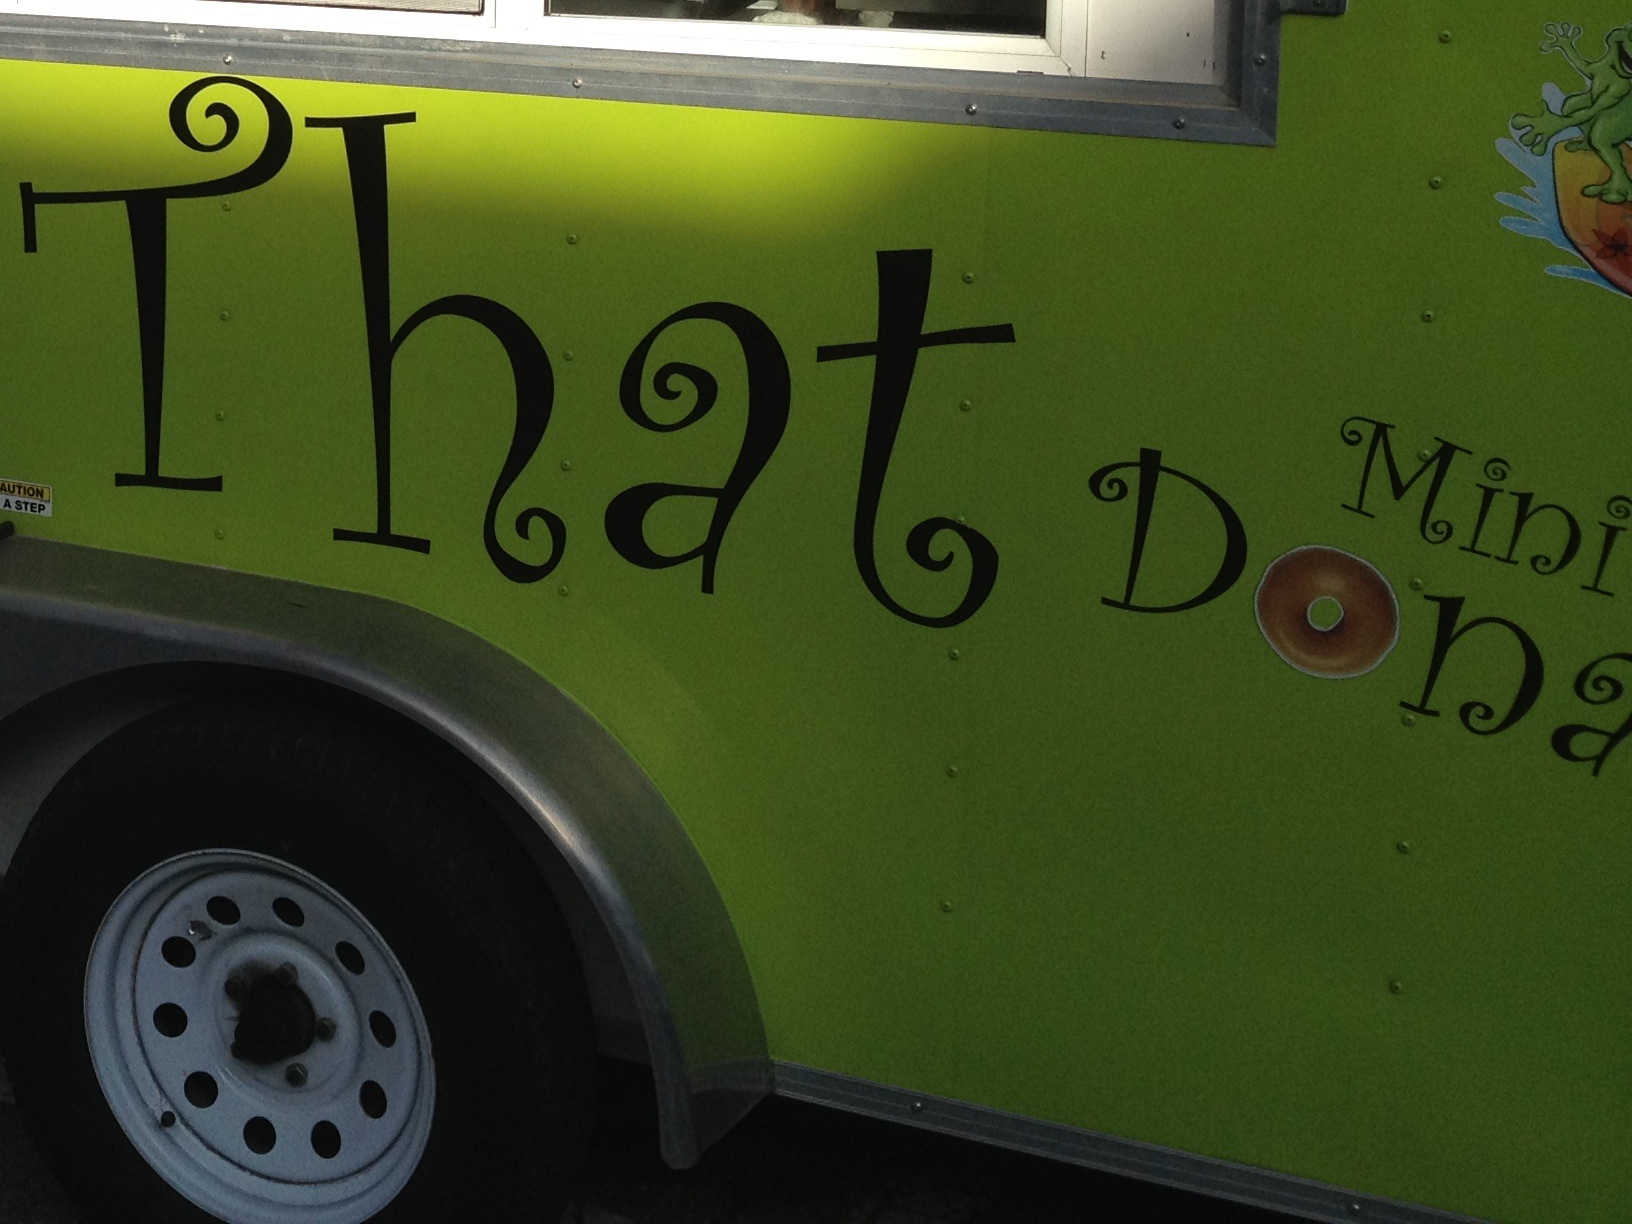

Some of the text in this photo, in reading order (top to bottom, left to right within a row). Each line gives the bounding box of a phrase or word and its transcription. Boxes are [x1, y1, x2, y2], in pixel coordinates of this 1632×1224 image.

[18, 74, 1018, 629] That
[3, 498, 12, 509] A
[14, 499, 46, 514] STEP
[1340, 414, 1632, 598] Mini
